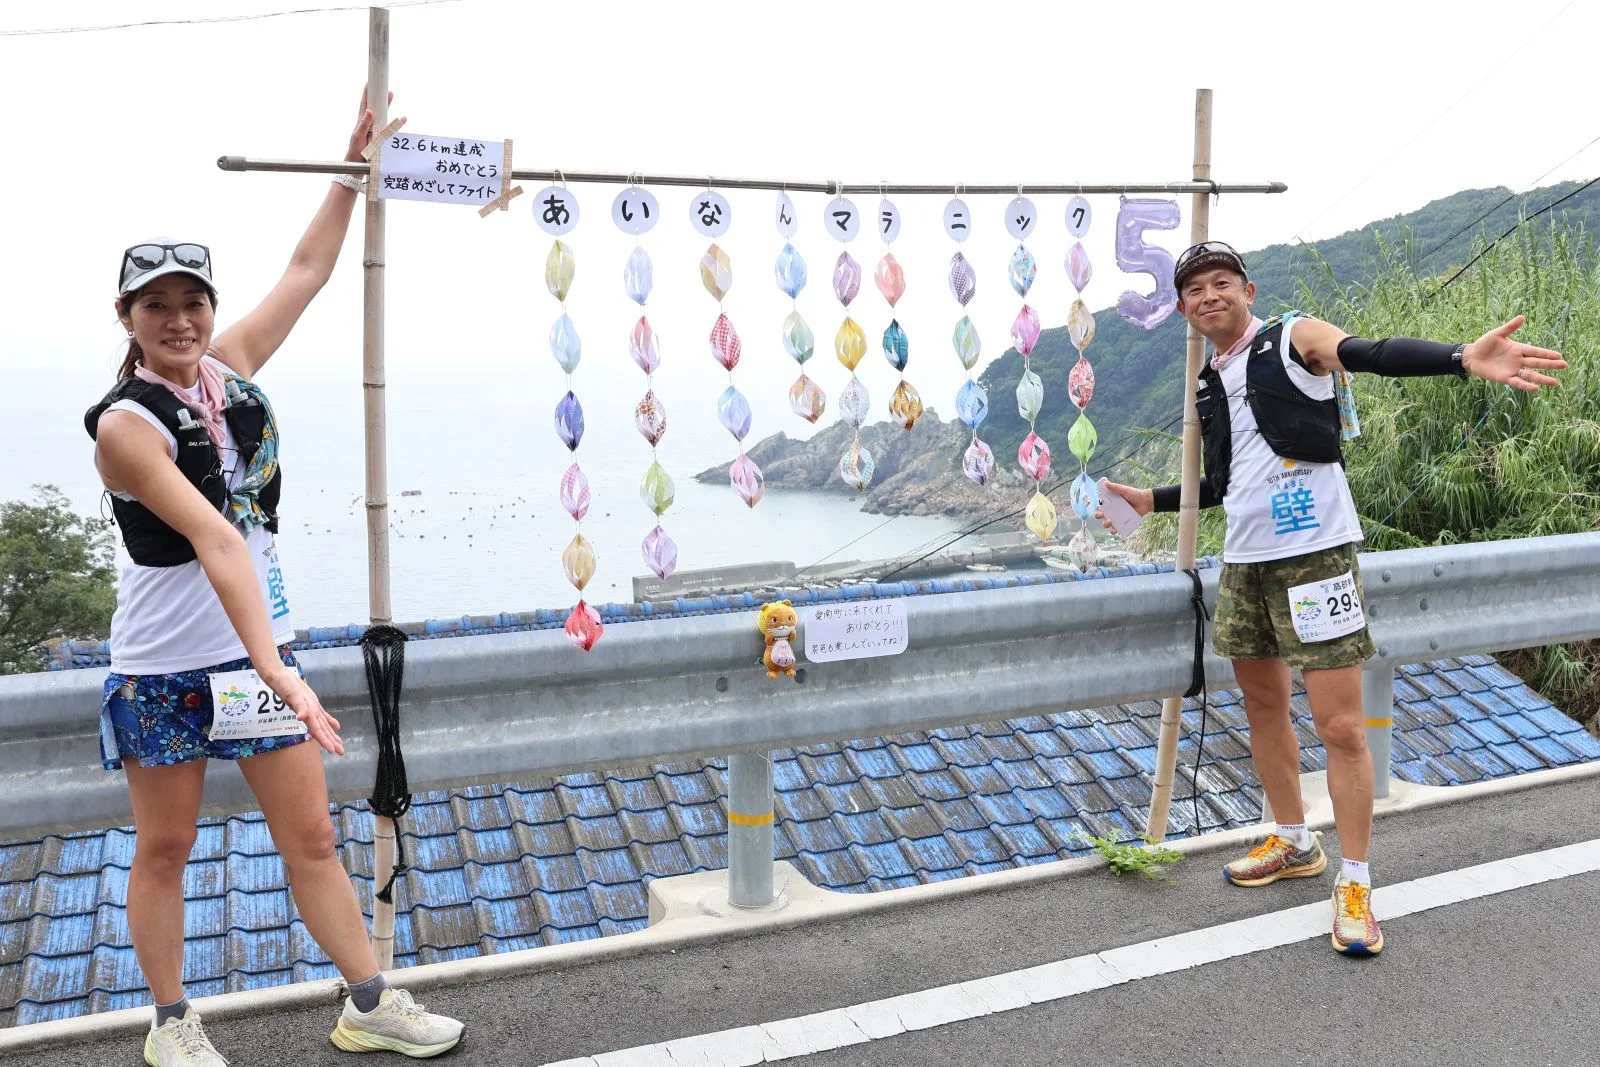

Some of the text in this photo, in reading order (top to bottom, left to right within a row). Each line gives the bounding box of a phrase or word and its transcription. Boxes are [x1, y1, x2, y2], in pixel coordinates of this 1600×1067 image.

[390, 137, 486, 157] 32.6km達成
[435, 159, 497, 178] おめでとう
[1115, 195, 1182, 330] 5
[1281, 468, 1314, 479] ANNIVERSARY
[1271, 487, 1320, 535] 壁
